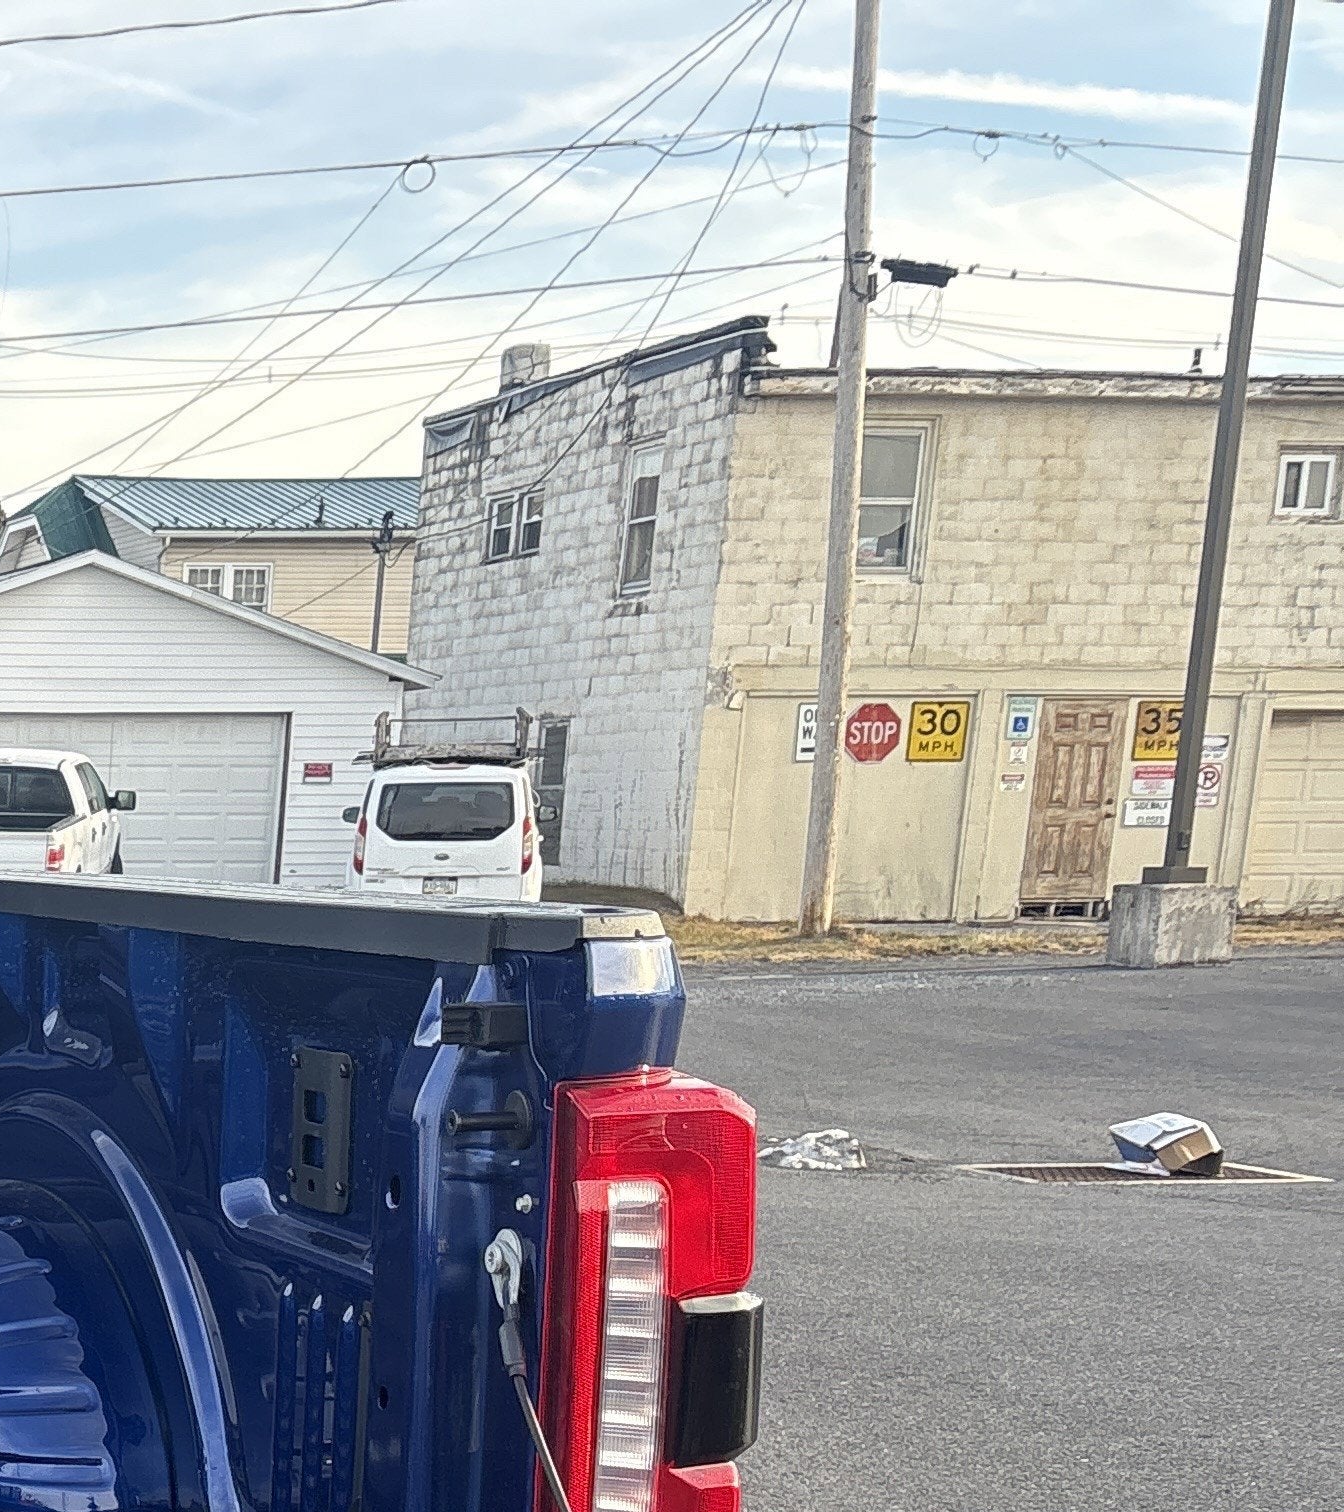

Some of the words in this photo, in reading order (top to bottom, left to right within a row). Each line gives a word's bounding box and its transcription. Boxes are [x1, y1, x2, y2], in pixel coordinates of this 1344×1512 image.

[848, 720, 898, 746] STOP
[916, 708, 961, 736] 30
[1141, 707, 1183, 735] 35
[918, 740, 955, 753] MPH
